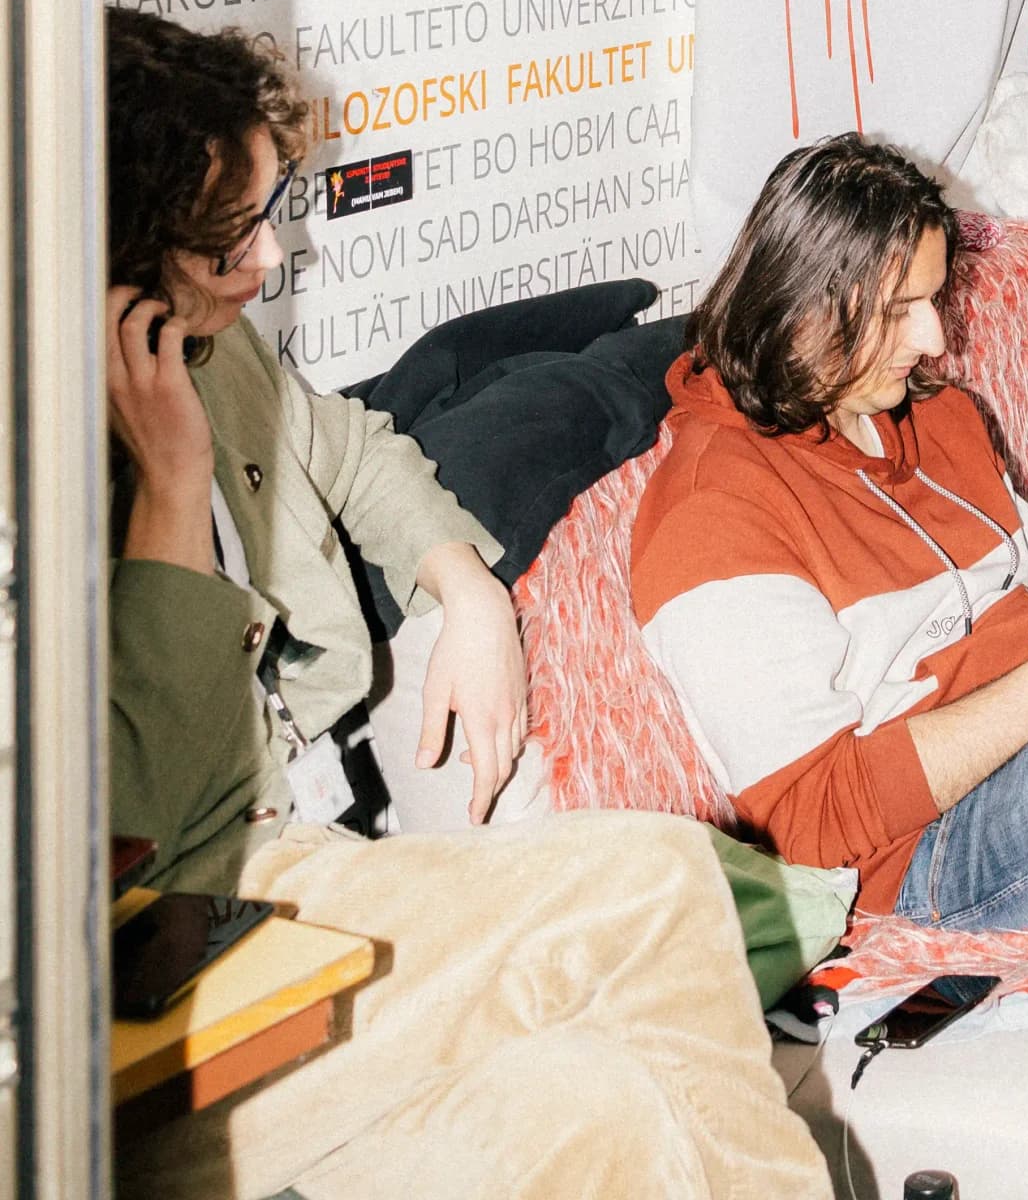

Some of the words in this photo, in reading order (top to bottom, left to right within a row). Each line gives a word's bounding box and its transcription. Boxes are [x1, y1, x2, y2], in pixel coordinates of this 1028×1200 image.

[296, 2, 488, 71] FAKULTETO
[310, 69, 487, 143] ILOZOFSKI
[507, 41, 652, 105] FAKULTET
[474, 133, 516, 180] ВО
[529, 111, 615, 168] НОВИ
[627, 99, 680, 148] САД
[262, 249, 307, 304] DE
[322, 226, 405, 288] NOVI
[417, 209, 480, 263] SAD
[492, 171, 631, 243] DARSHAN
[641, 158, 690, 206] SHA
[420, 236, 613, 328] UNIVERSITÄT
[621, 221, 686, 274] NOVI
